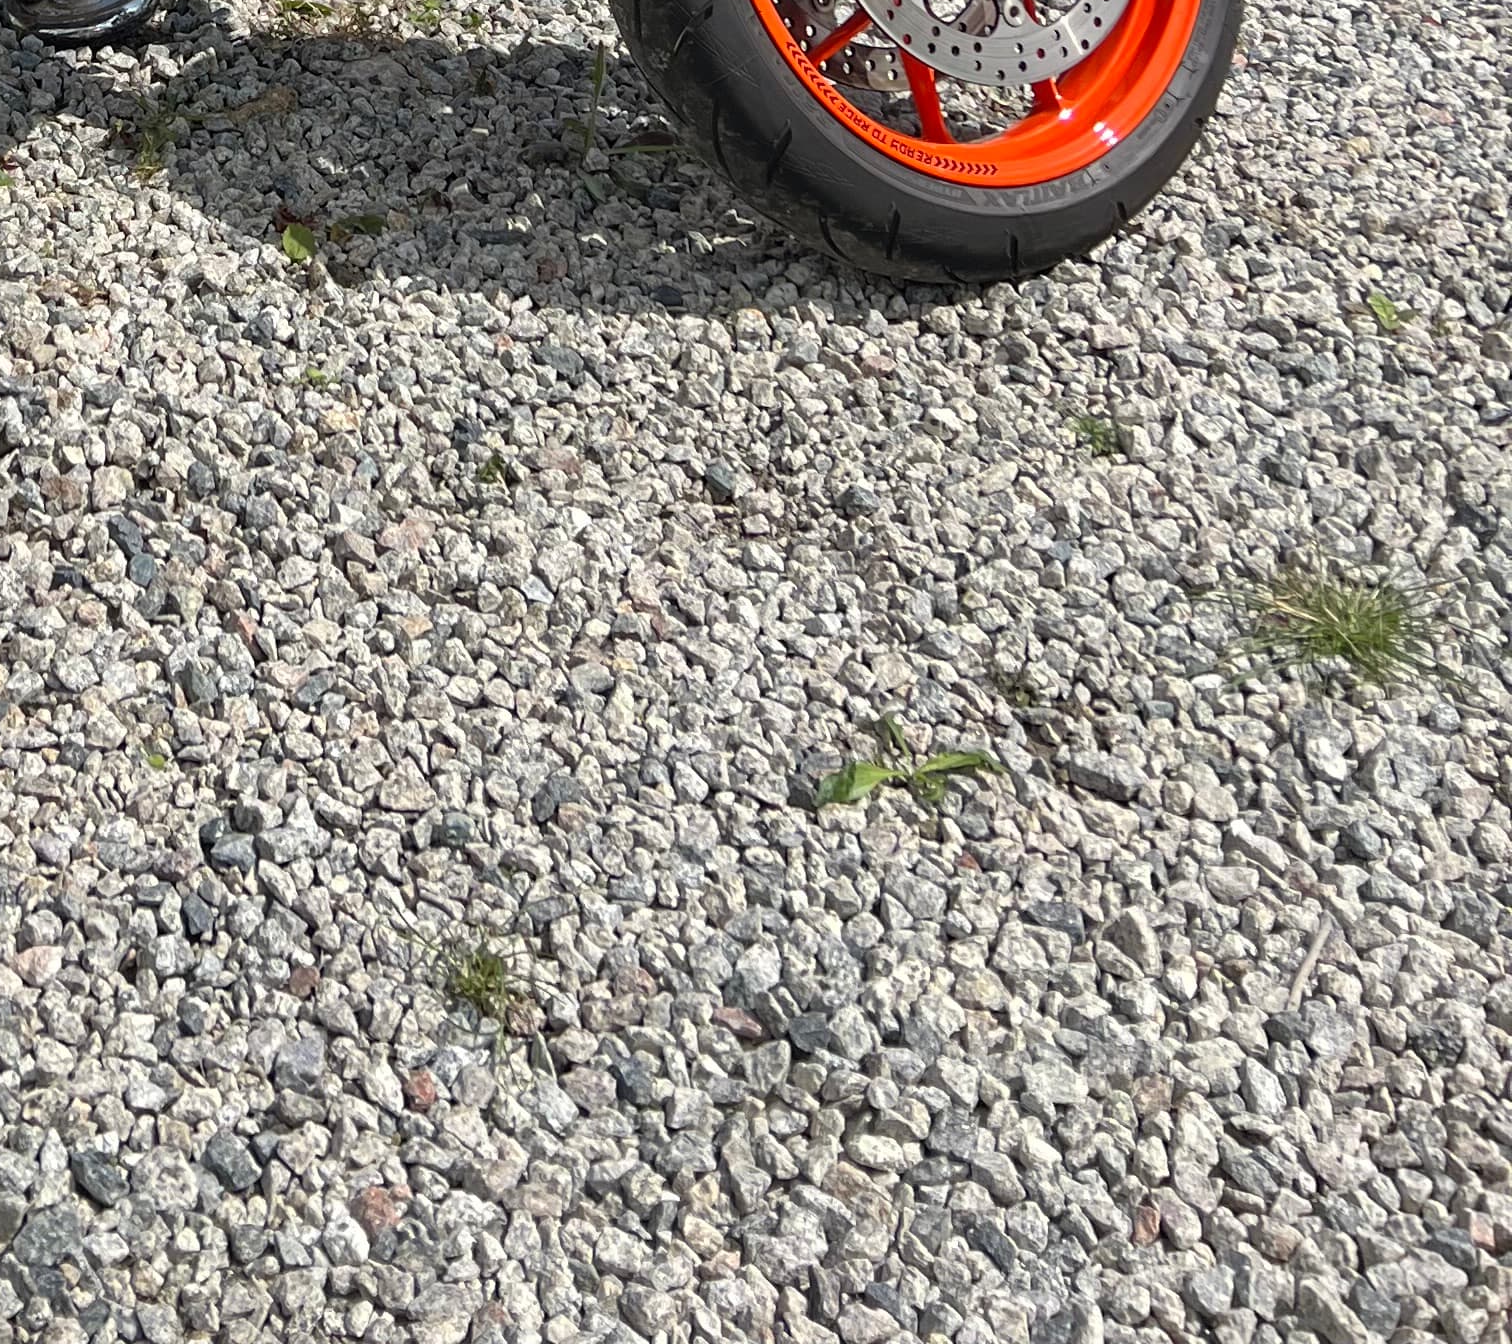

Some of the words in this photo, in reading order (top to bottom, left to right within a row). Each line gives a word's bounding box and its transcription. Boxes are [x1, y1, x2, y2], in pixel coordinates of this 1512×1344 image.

[837, 102, 870, 131] RACE
[871, 128, 887, 145] TO
[890, 140, 934, 166] READY
